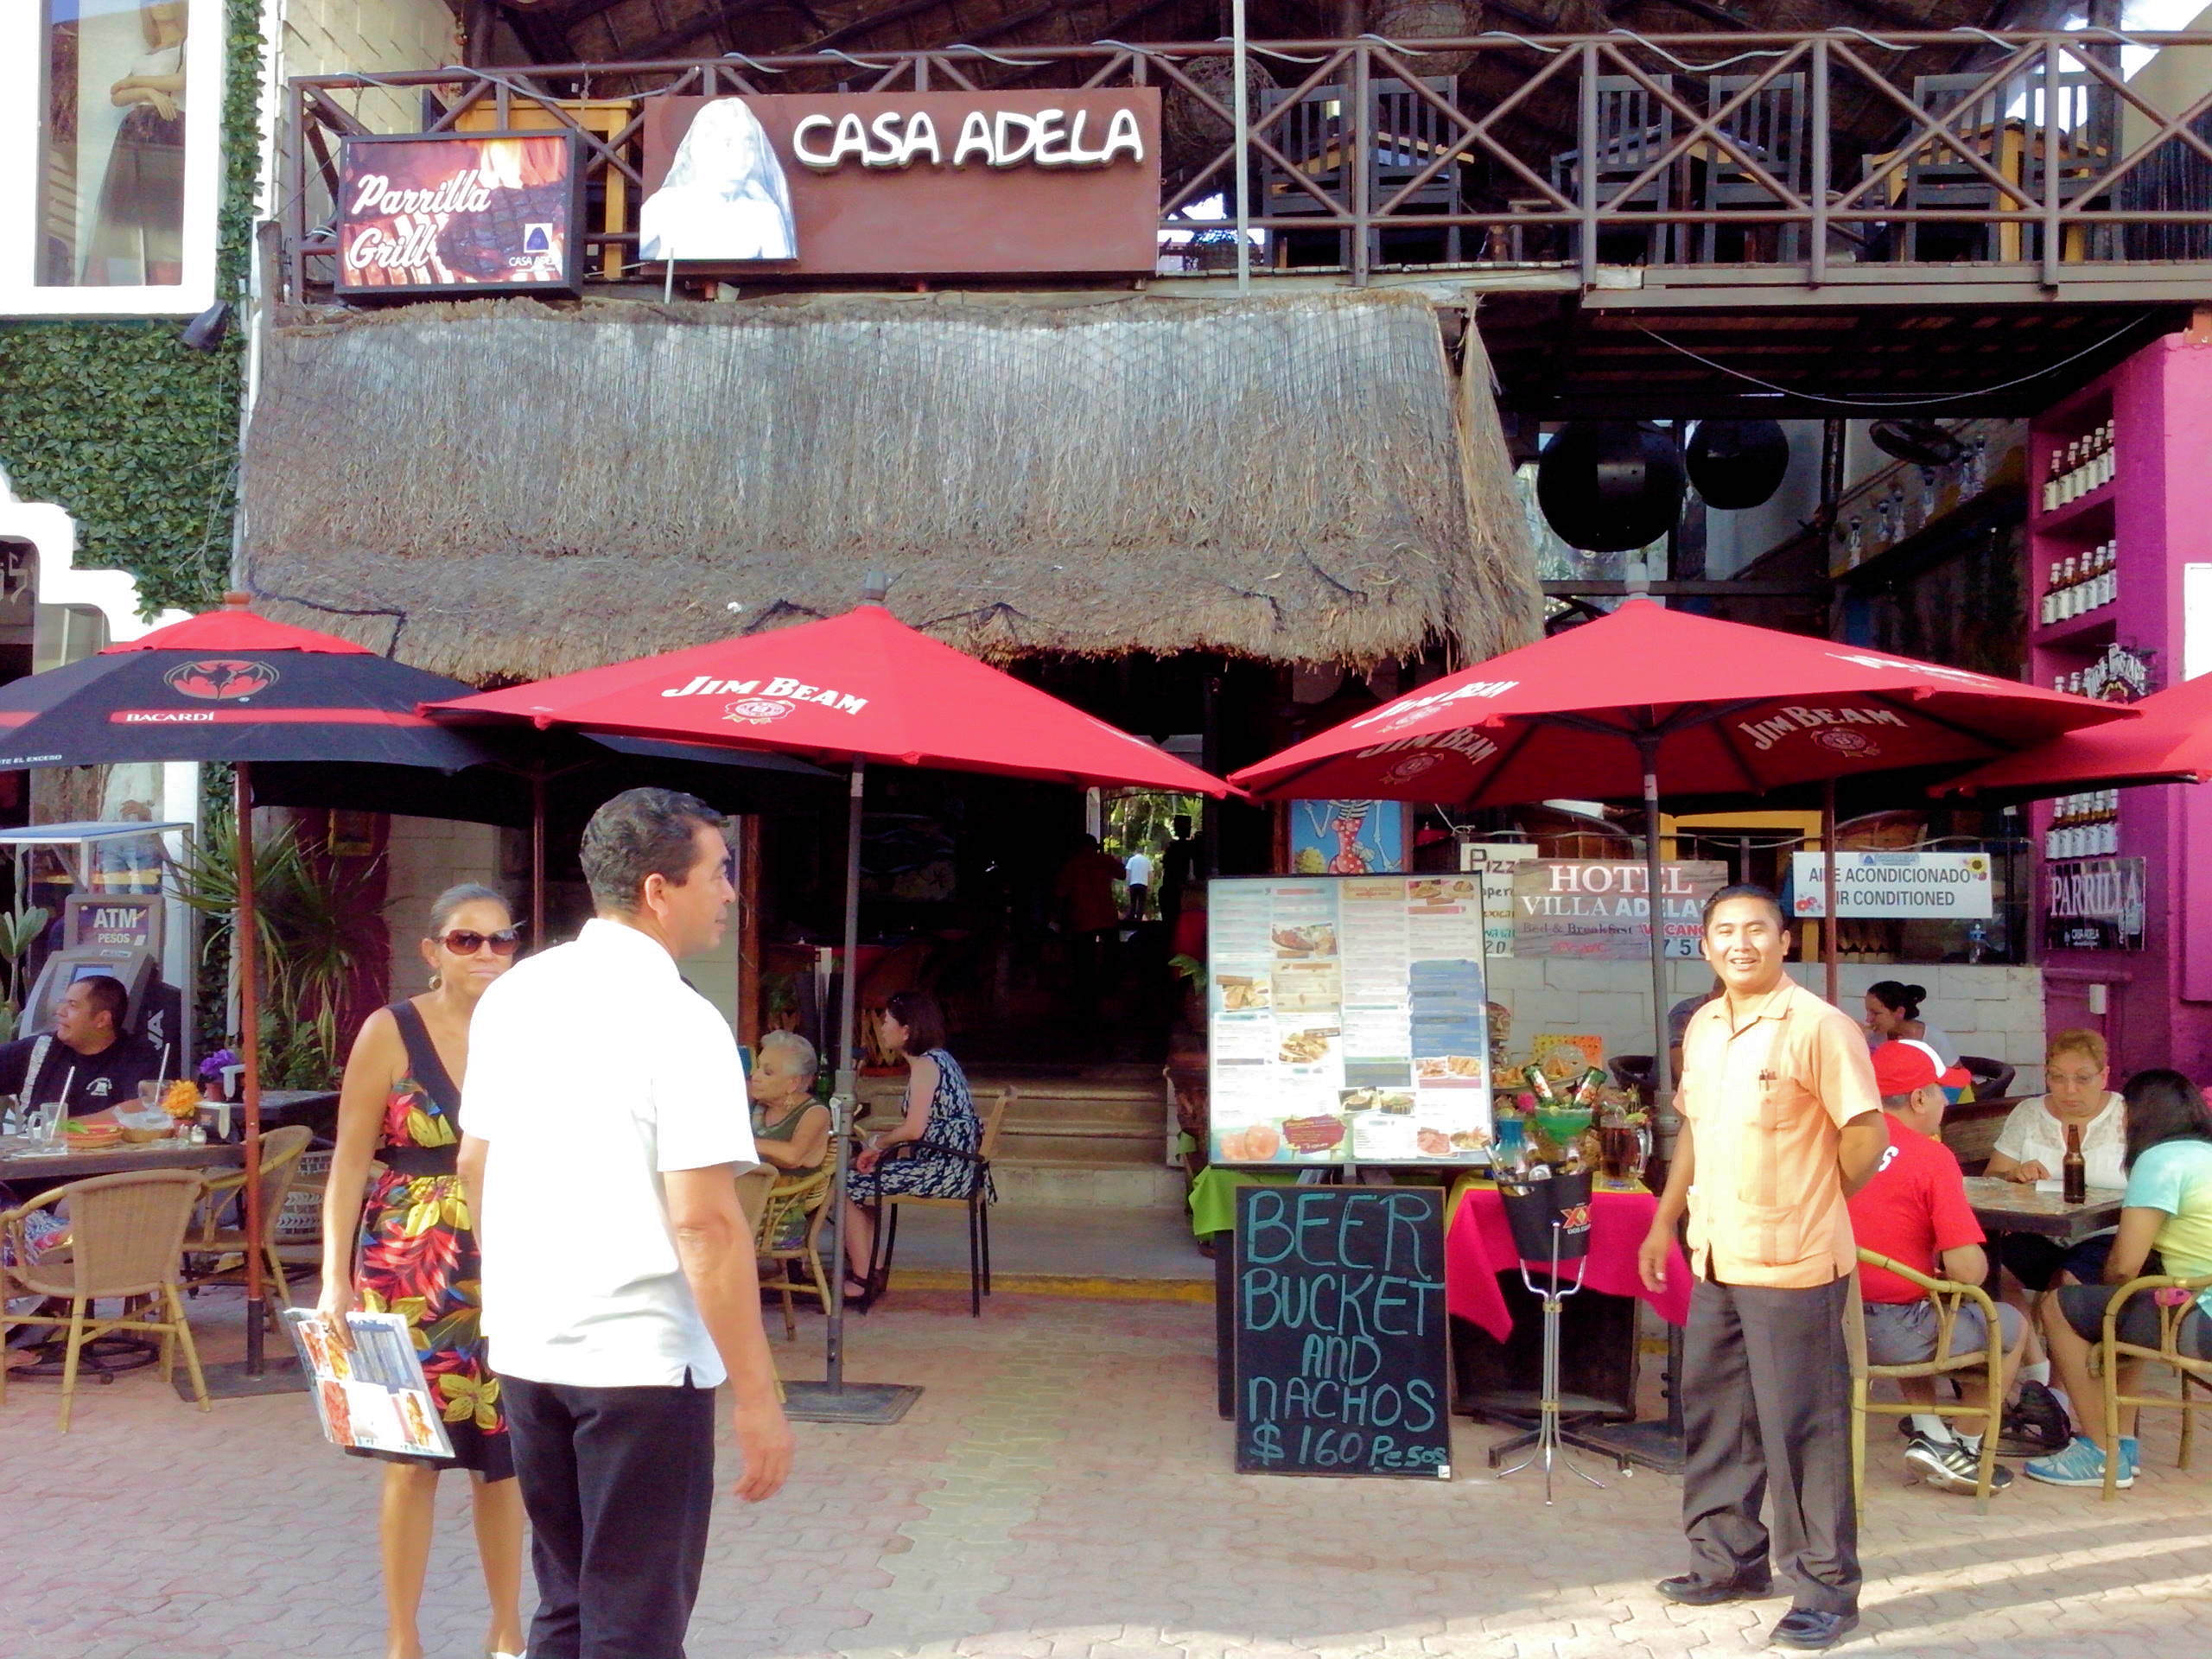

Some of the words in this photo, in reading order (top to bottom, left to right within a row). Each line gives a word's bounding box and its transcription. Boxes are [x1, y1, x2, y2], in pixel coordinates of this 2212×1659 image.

[792, 110, 939, 166] CASA
[953, 108, 1144, 166] ADELA
[351, 168, 492, 215] Parrilla
[347, 222, 437, 270] Grill
[661, 676, 762, 697] JIM
[759, 676, 869, 715] BEAM
[1737, 715, 1799, 751] JIM
[1780, 705, 1910, 728] BEAM
[1470, 848, 1516, 874] PIZZ
[1808, 868, 1841, 883] AIE
[1845, 868, 1971, 884] ACONDICIONADO
[1521, 895, 1611, 917] VILLA
[1614, 897, 1707, 918] ADLA'
[1853, 890, 1955, 906] CONDITIONED
[2050, 870, 2141, 917] PARRILLA
[92, 907, 137, 928] ATM
[98, 933, 130, 944] PESOS
[1247, 1190, 1433, 1281] BEER
[1242, 1267, 1446, 1339] BUCKET
[1301, 1332, 1382, 1386] AND
[1249, 1376, 1436, 1433] NACHOS
